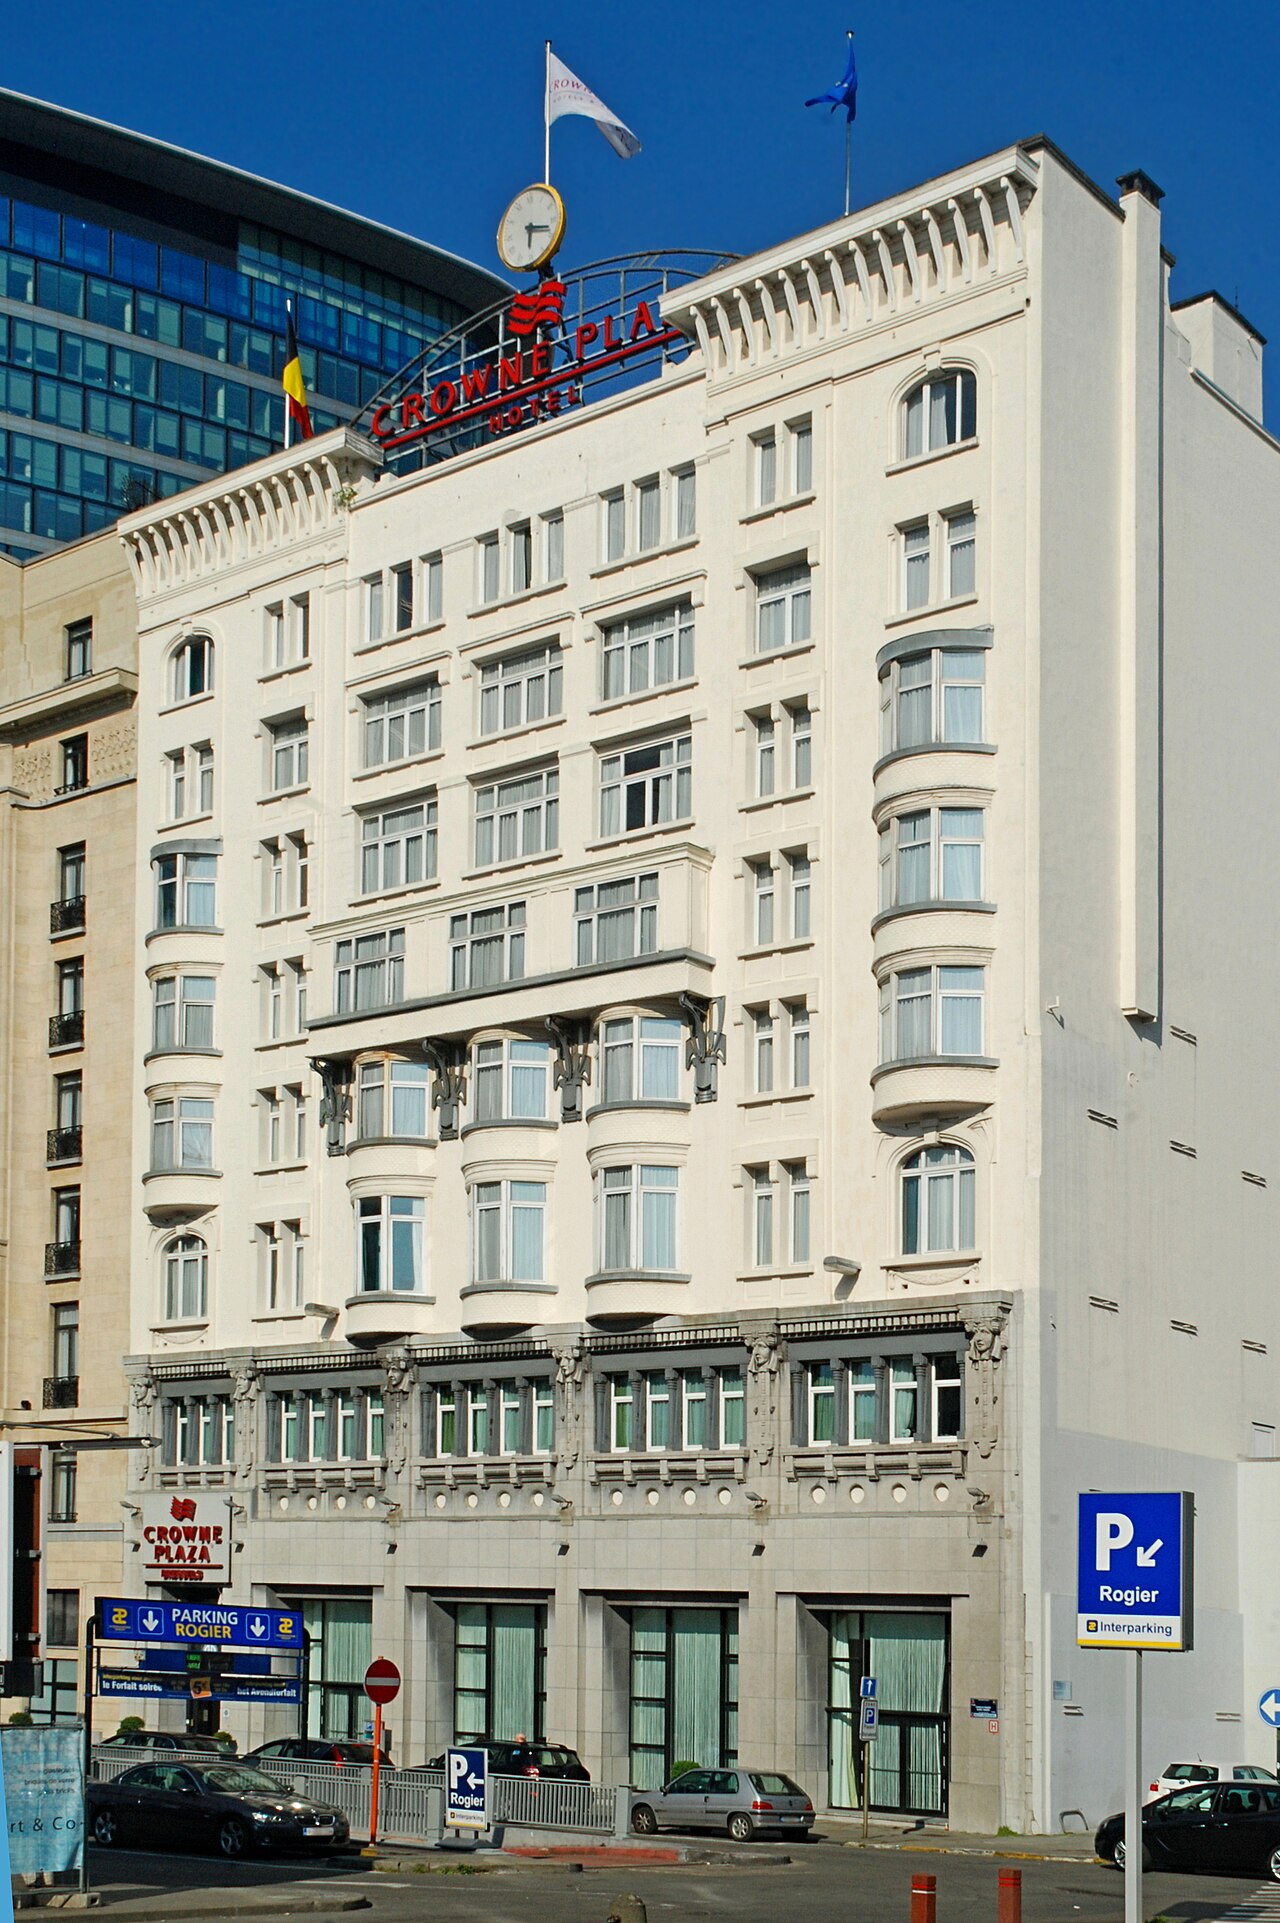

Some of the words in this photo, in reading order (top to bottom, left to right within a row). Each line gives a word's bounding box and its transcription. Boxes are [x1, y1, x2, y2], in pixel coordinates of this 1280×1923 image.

[372, 340, 552, 437] CROWNE
[576, 301, 673, 361] PLA
[489, 385, 580, 434] HOTEL
[143, 1525, 223, 1545] CROWNE
[1096, 1513, 1134, 1571] P
[154, 1545, 211, 1563] PLAZA
[1099, 1585, 1159, 1607] Rogier
[171, 1608, 239, 1626] PARKING
[175, 1623, 232, 1639] ROGIER
[1100, 1621, 1173, 1637] Interparking
[866, 1709, 874, 1723] P
[450, 1754, 468, 1789] P
[450, 1792, 484, 1808] Rogier
[32, 1817, 43, 1832] &
